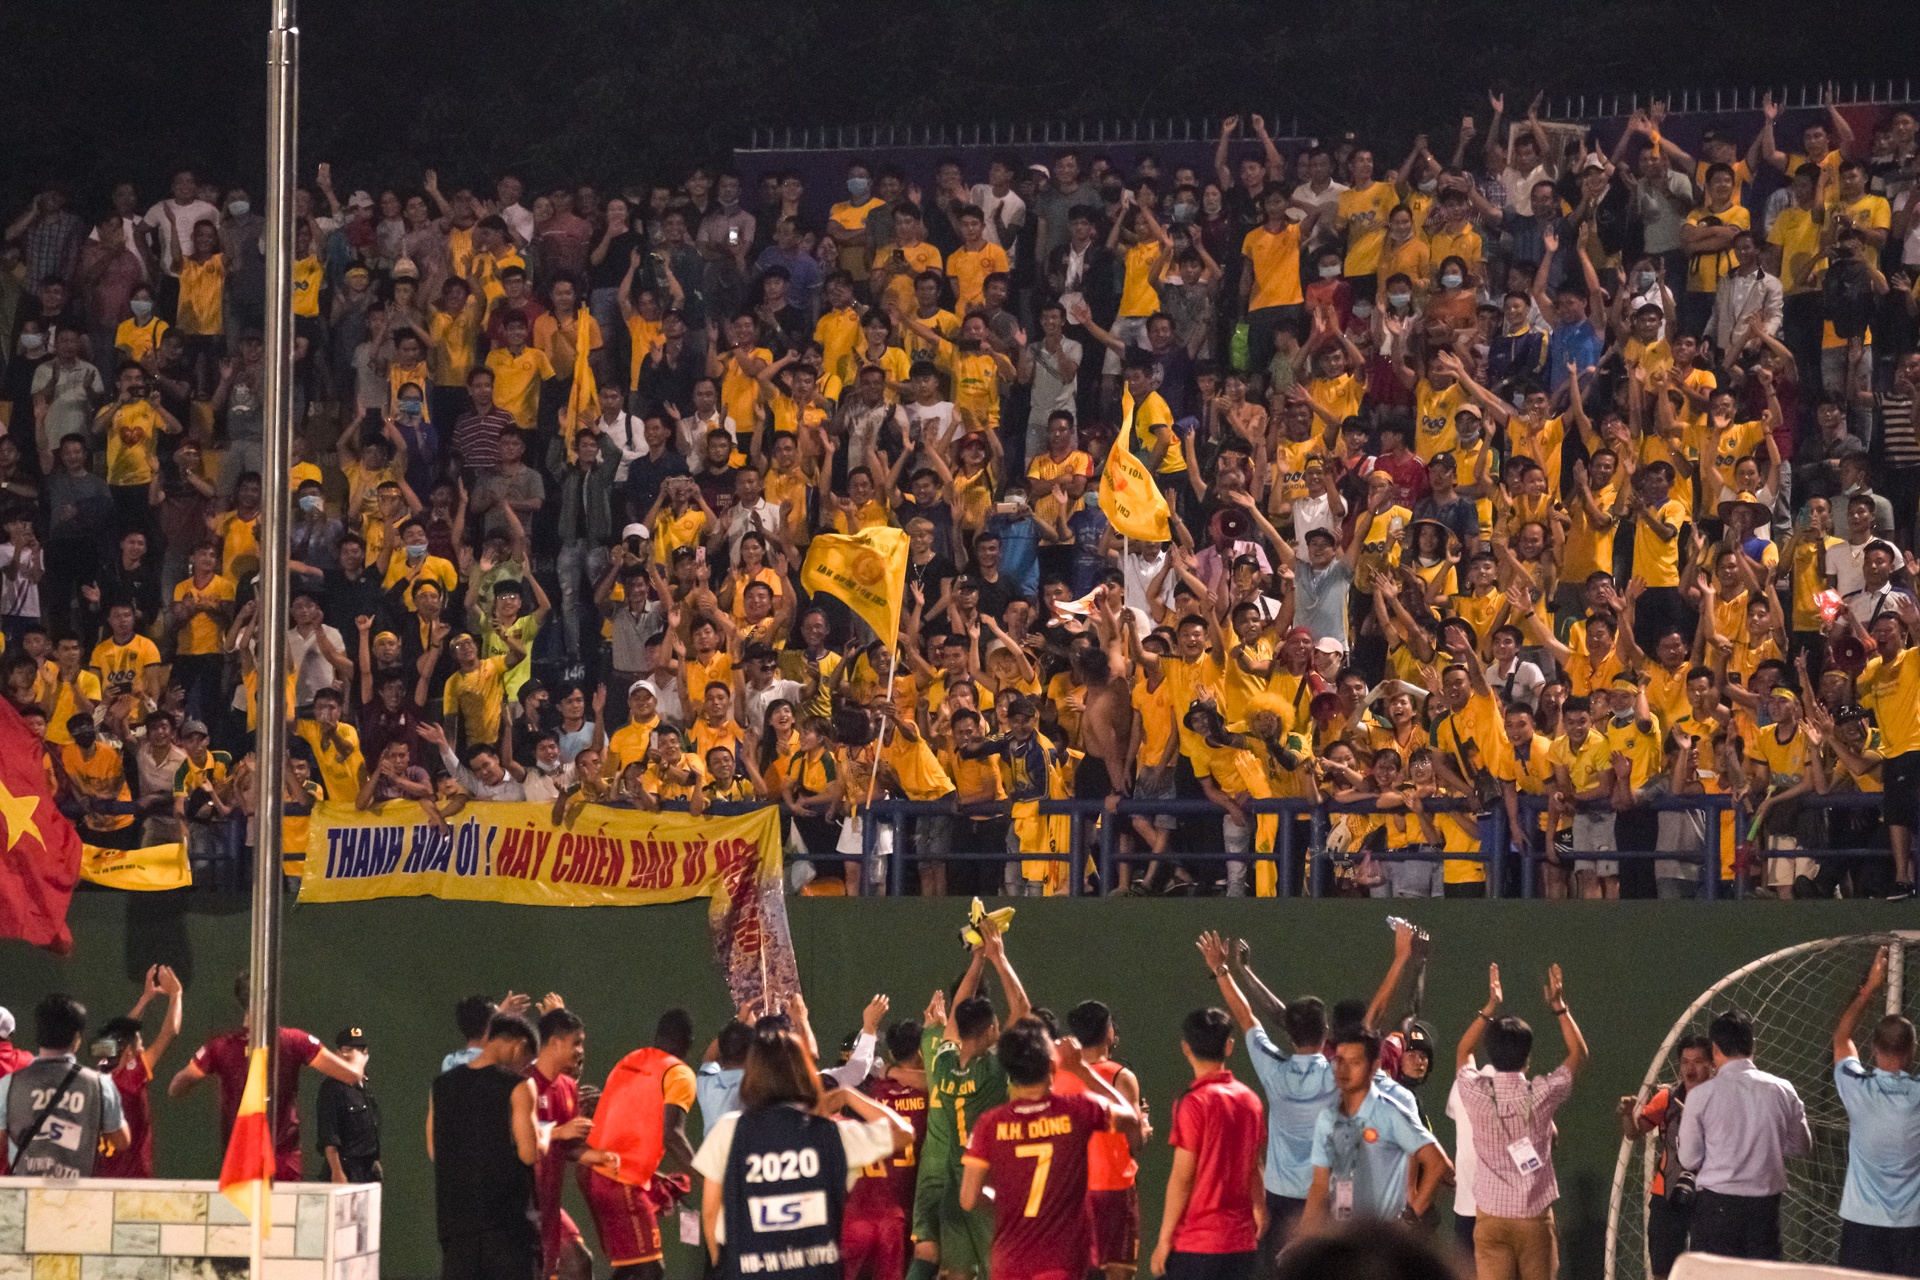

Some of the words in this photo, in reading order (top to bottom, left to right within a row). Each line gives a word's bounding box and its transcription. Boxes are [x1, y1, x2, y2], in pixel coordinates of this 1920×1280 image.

[564, 665, 586, 681] 146
[325, 826, 405, 879] THANH
[496, 821, 552, 880] HÃY
[550, 821, 624, 888] CHIẾN
[681, 832, 709, 887] VÌ
[745, 1147, 820, 1183] 2020
[1015, 1143, 1054, 1218] 7
[761, 1202, 802, 1227] LS
